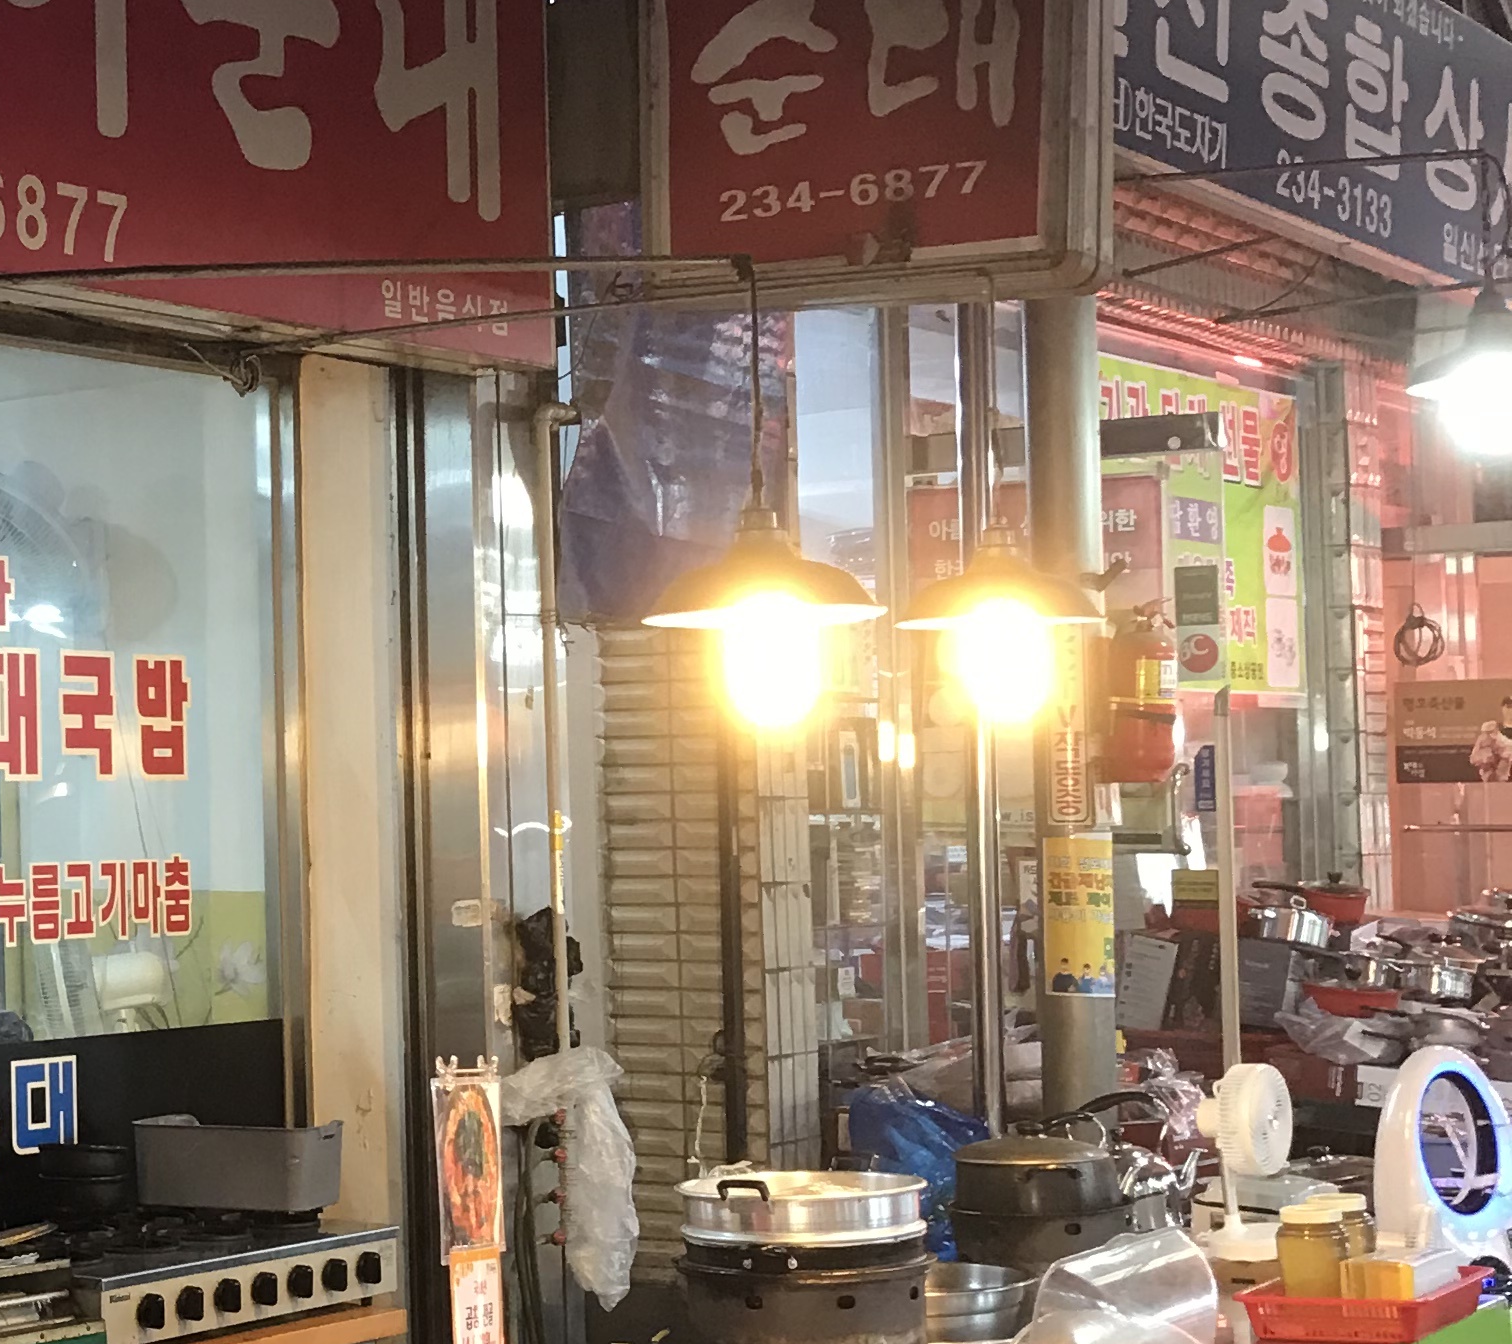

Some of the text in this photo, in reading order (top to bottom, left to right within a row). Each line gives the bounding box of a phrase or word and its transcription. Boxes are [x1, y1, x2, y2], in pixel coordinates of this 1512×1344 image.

[1135, 86, 1227, 170] 한국도자기
[719, 159, 987, 224] 234-6877
[1276, 148, 1392, 238] 234-3133
[381, 280, 509, 336] 일반음식점
